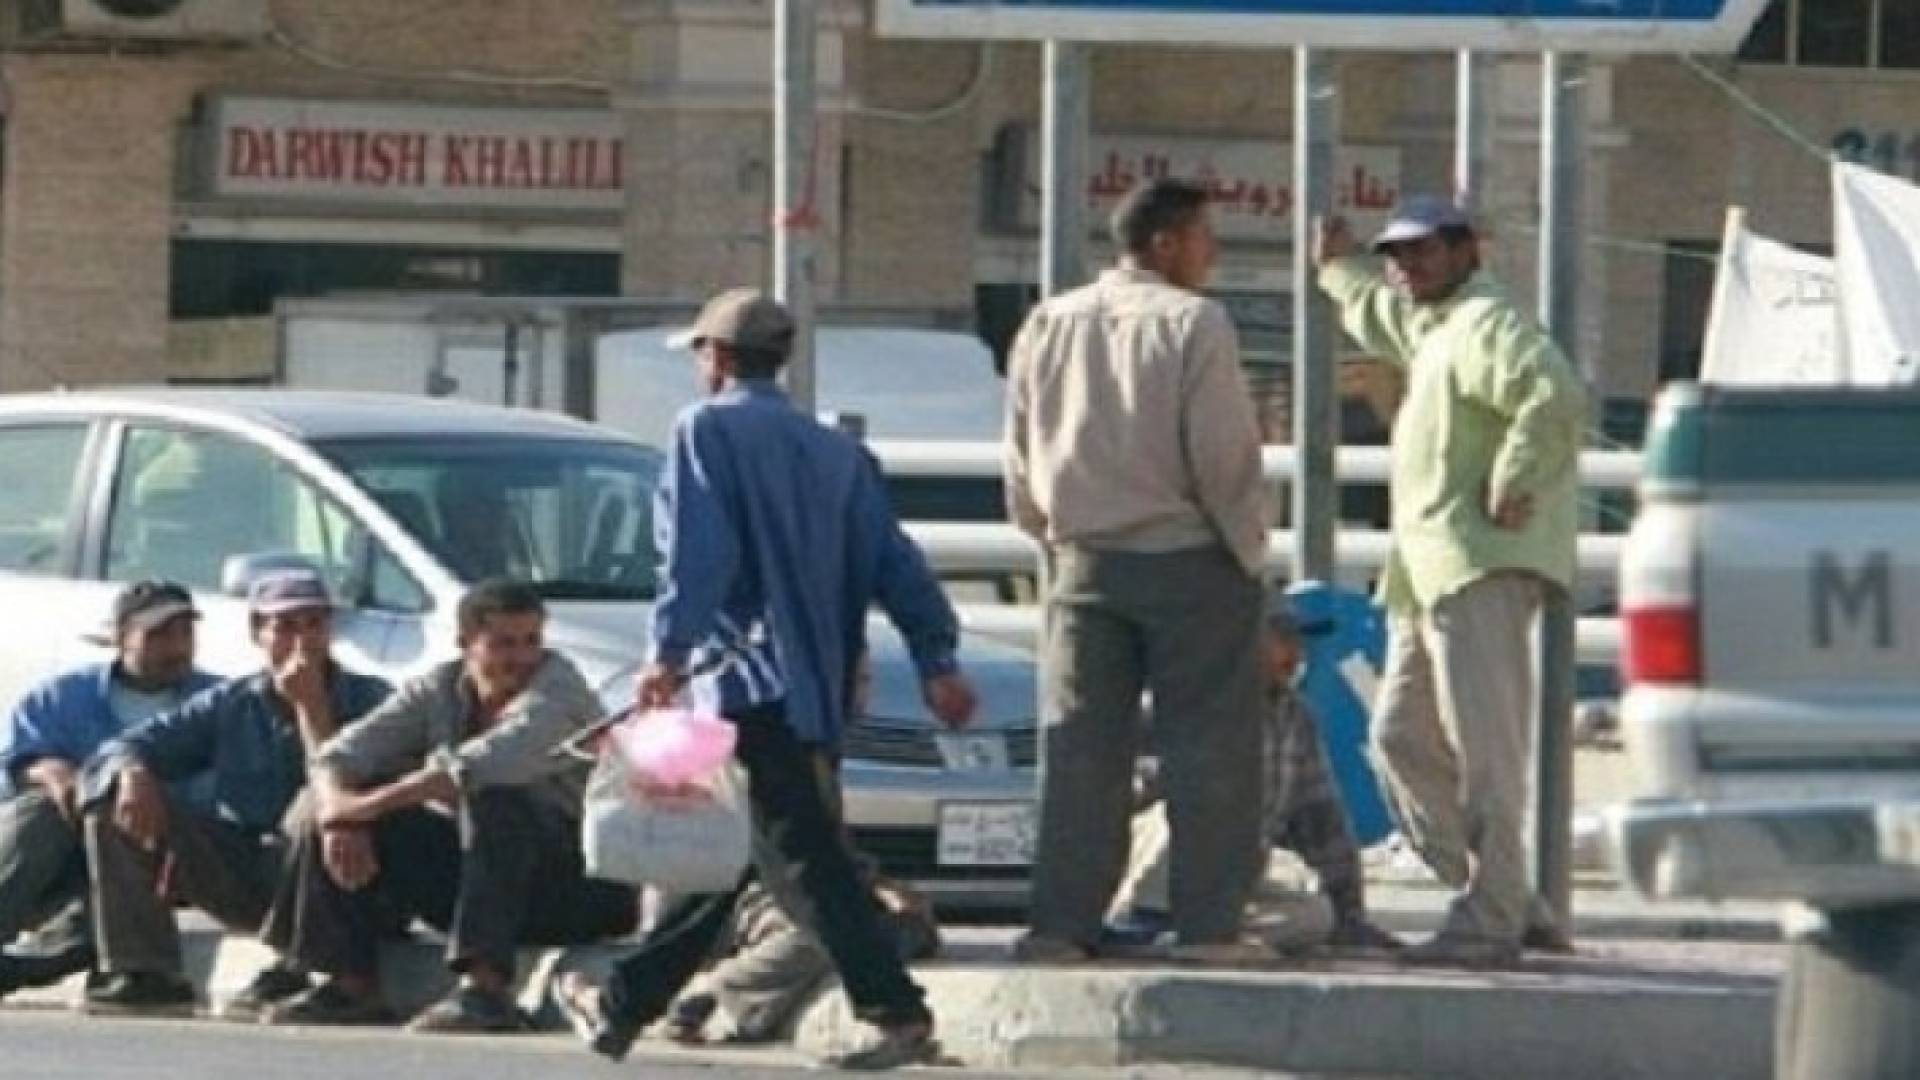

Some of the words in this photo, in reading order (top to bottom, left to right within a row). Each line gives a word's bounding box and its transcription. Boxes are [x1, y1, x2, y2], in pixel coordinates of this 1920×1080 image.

[227, 125, 427, 187] DARWISH
[443, 131, 624, 190] KHALILI
[1809, 548, 1893, 649] M
